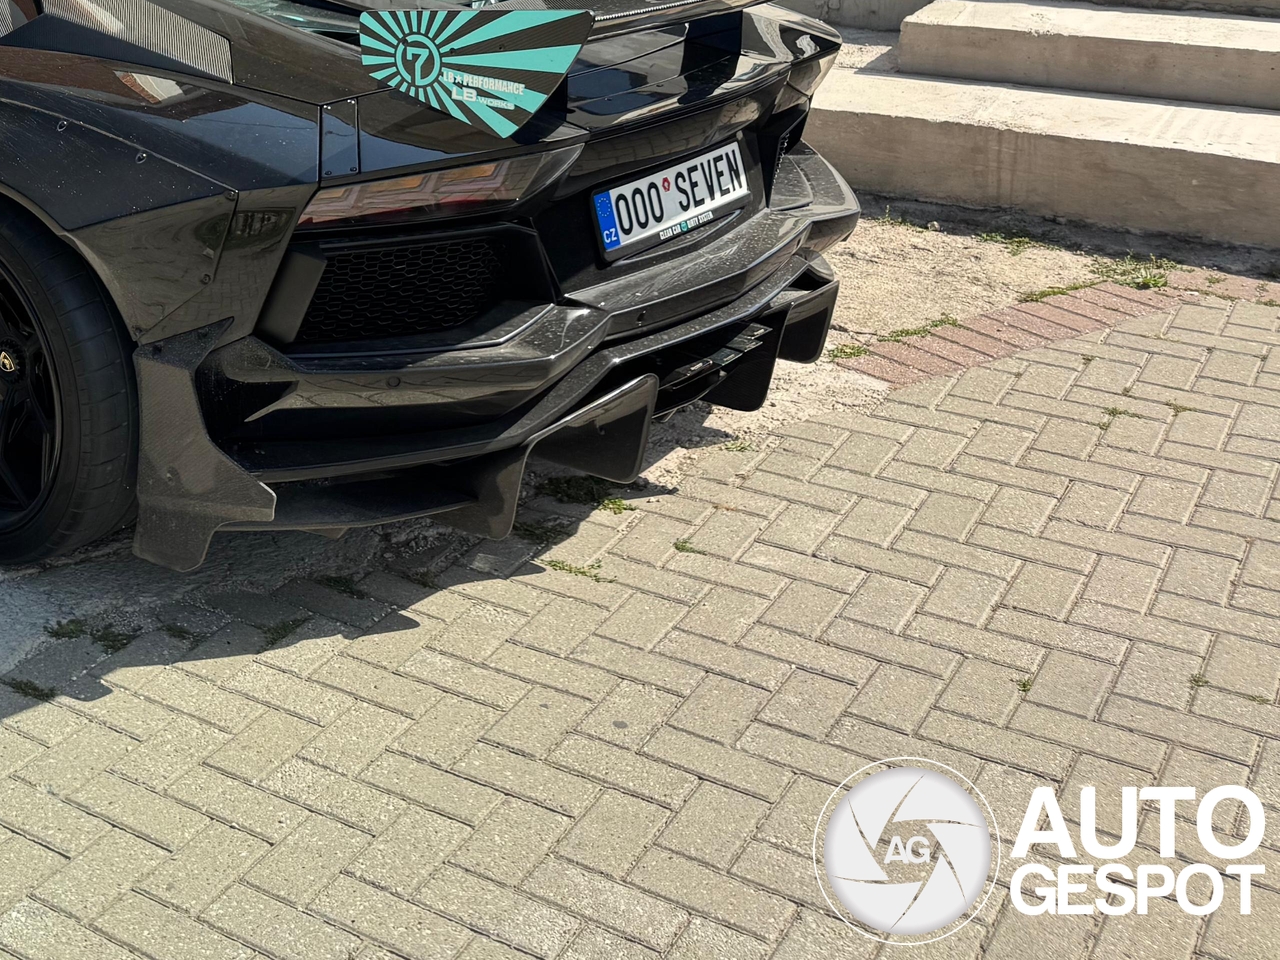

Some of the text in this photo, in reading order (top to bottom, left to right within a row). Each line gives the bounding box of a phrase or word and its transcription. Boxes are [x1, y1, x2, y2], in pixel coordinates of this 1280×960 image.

[463, 73, 526, 96] PERFORMANCE
[675, 150, 742, 212] SEVEN
[603, 228, 618, 244] CZ
